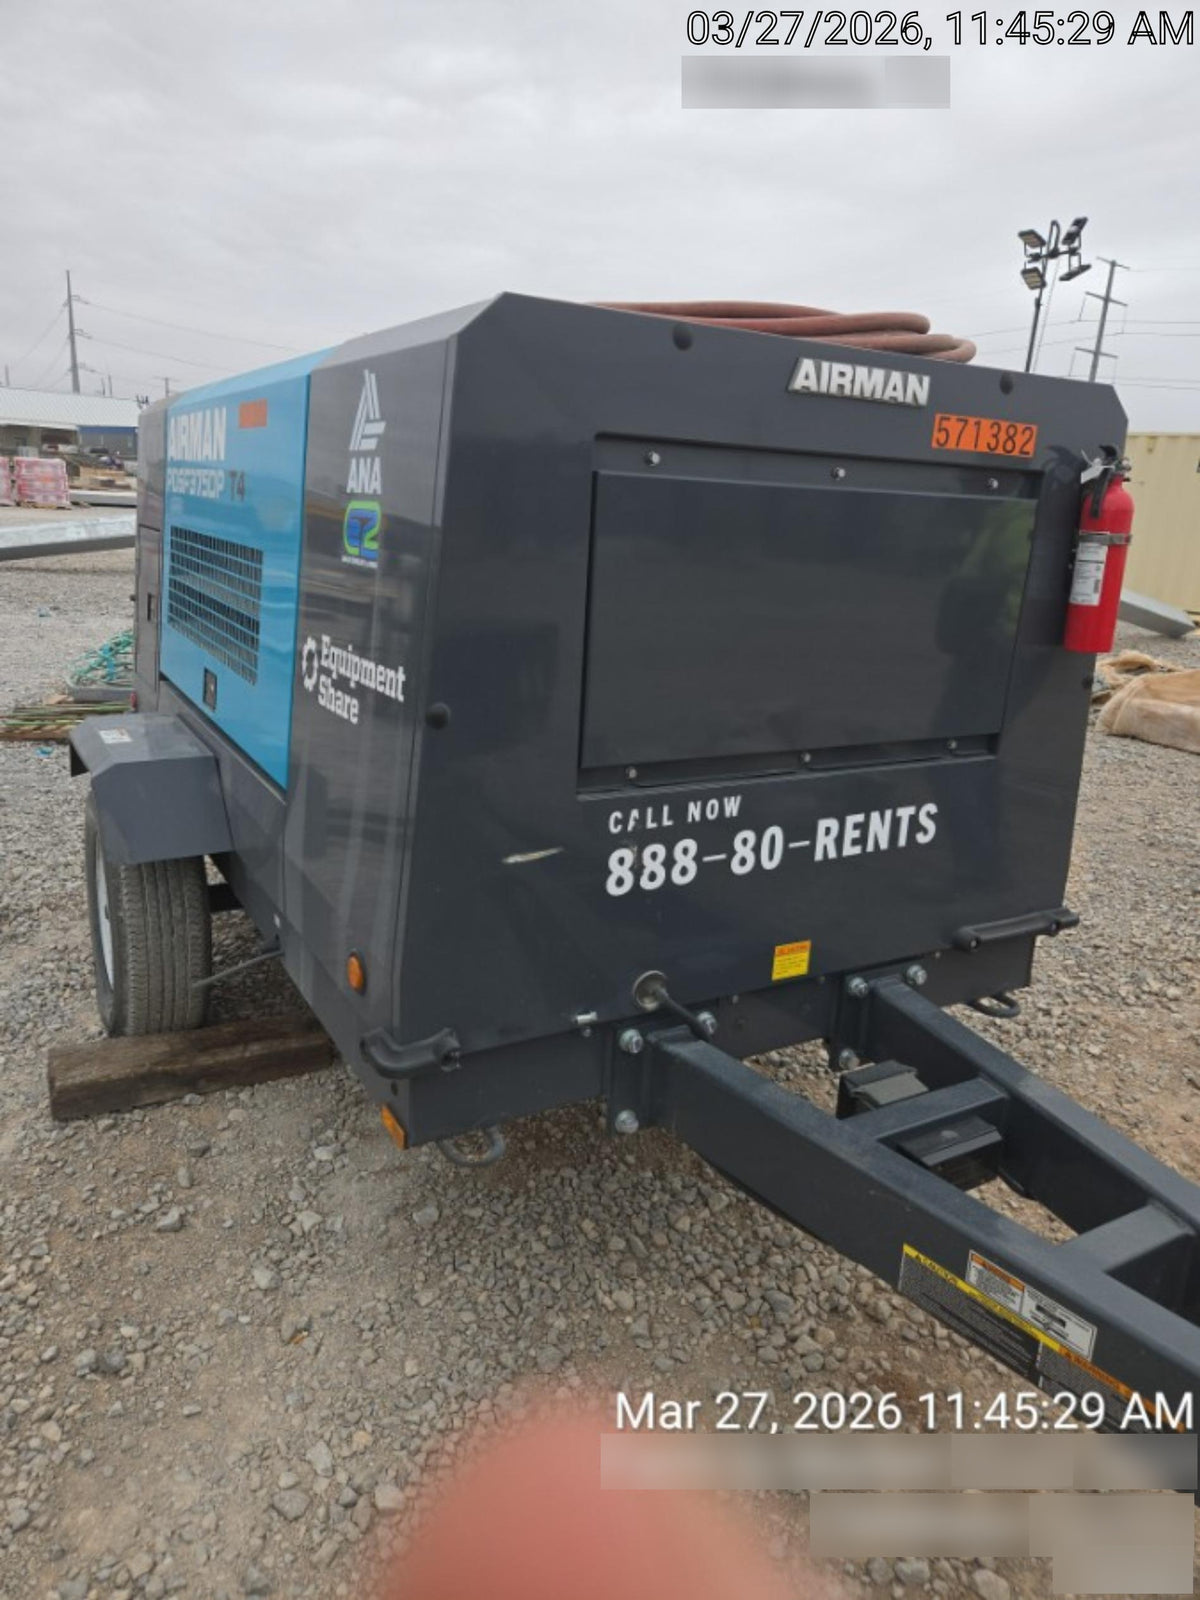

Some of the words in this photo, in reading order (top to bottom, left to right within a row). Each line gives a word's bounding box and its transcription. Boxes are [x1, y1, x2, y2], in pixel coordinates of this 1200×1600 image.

[790, 357, 931, 407] AIRMAN
[167, 405, 227, 461] AIRMAN
[935, 415, 1035, 456] 571382
[229, 469, 246, 502] T4
[346, 456, 382, 495] ANA
[320, 633, 406, 703] Equipment
[317, 673, 360, 725] Share
[608, 804, 674, 834] CALL
[687, 795, 742, 823] NOW
[605, 802, 939, 897] 888-80-RENTS
